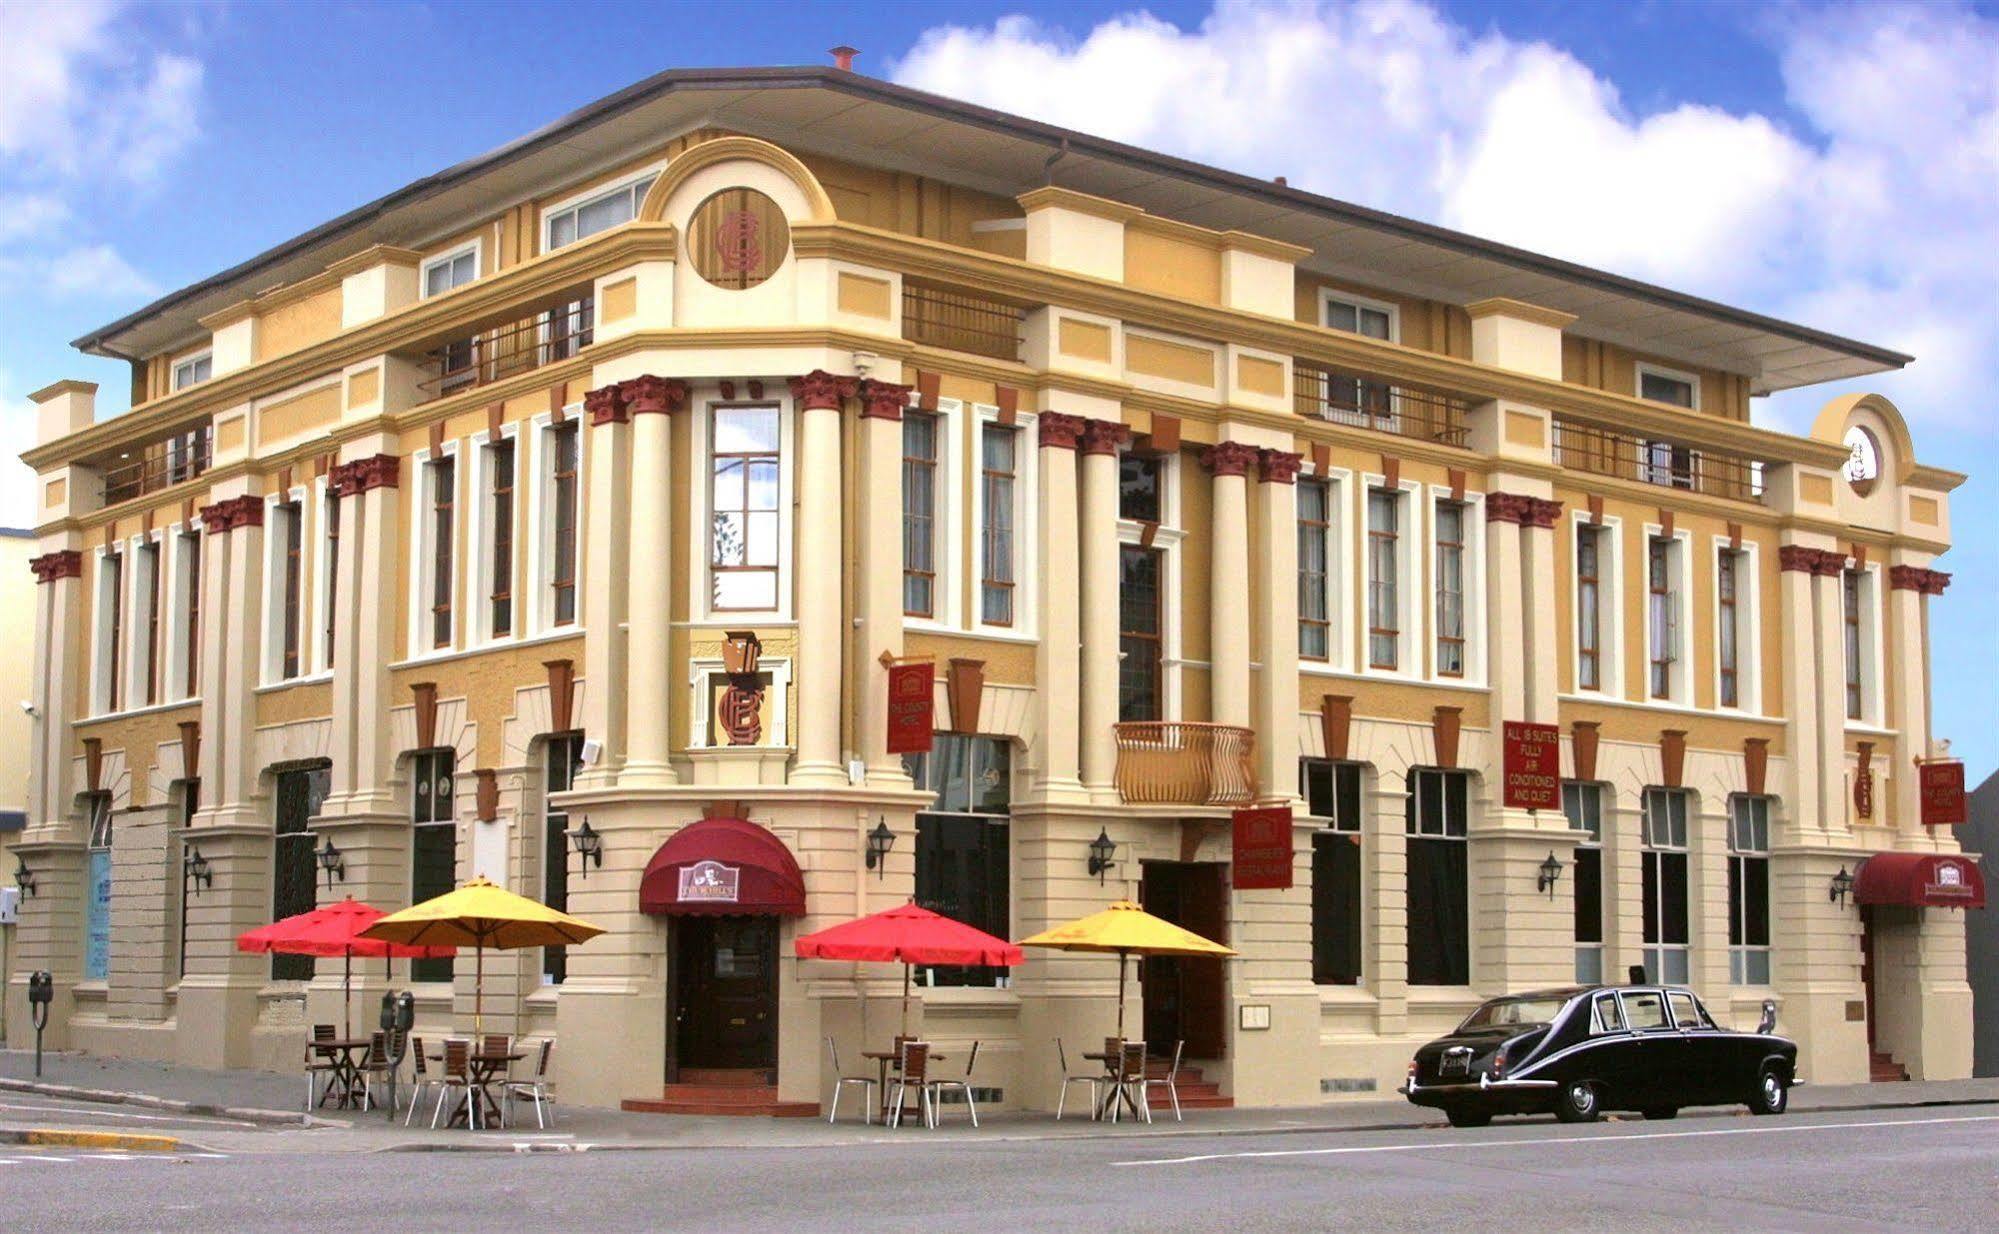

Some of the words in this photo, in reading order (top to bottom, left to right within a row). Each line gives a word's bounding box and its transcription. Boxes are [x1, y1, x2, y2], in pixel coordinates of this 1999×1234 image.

[1507, 728, 1521, 741] ALL
[1533, 730, 1557, 744] SUITES
[1520, 744, 1542, 757] FULLY
[1525, 760, 1538, 771] AIR
[1509, 774, 1554, 788] CONDITIONED
[1514, 787, 1529, 800] AND
[1531, 790, 1551, 802] QUIET
